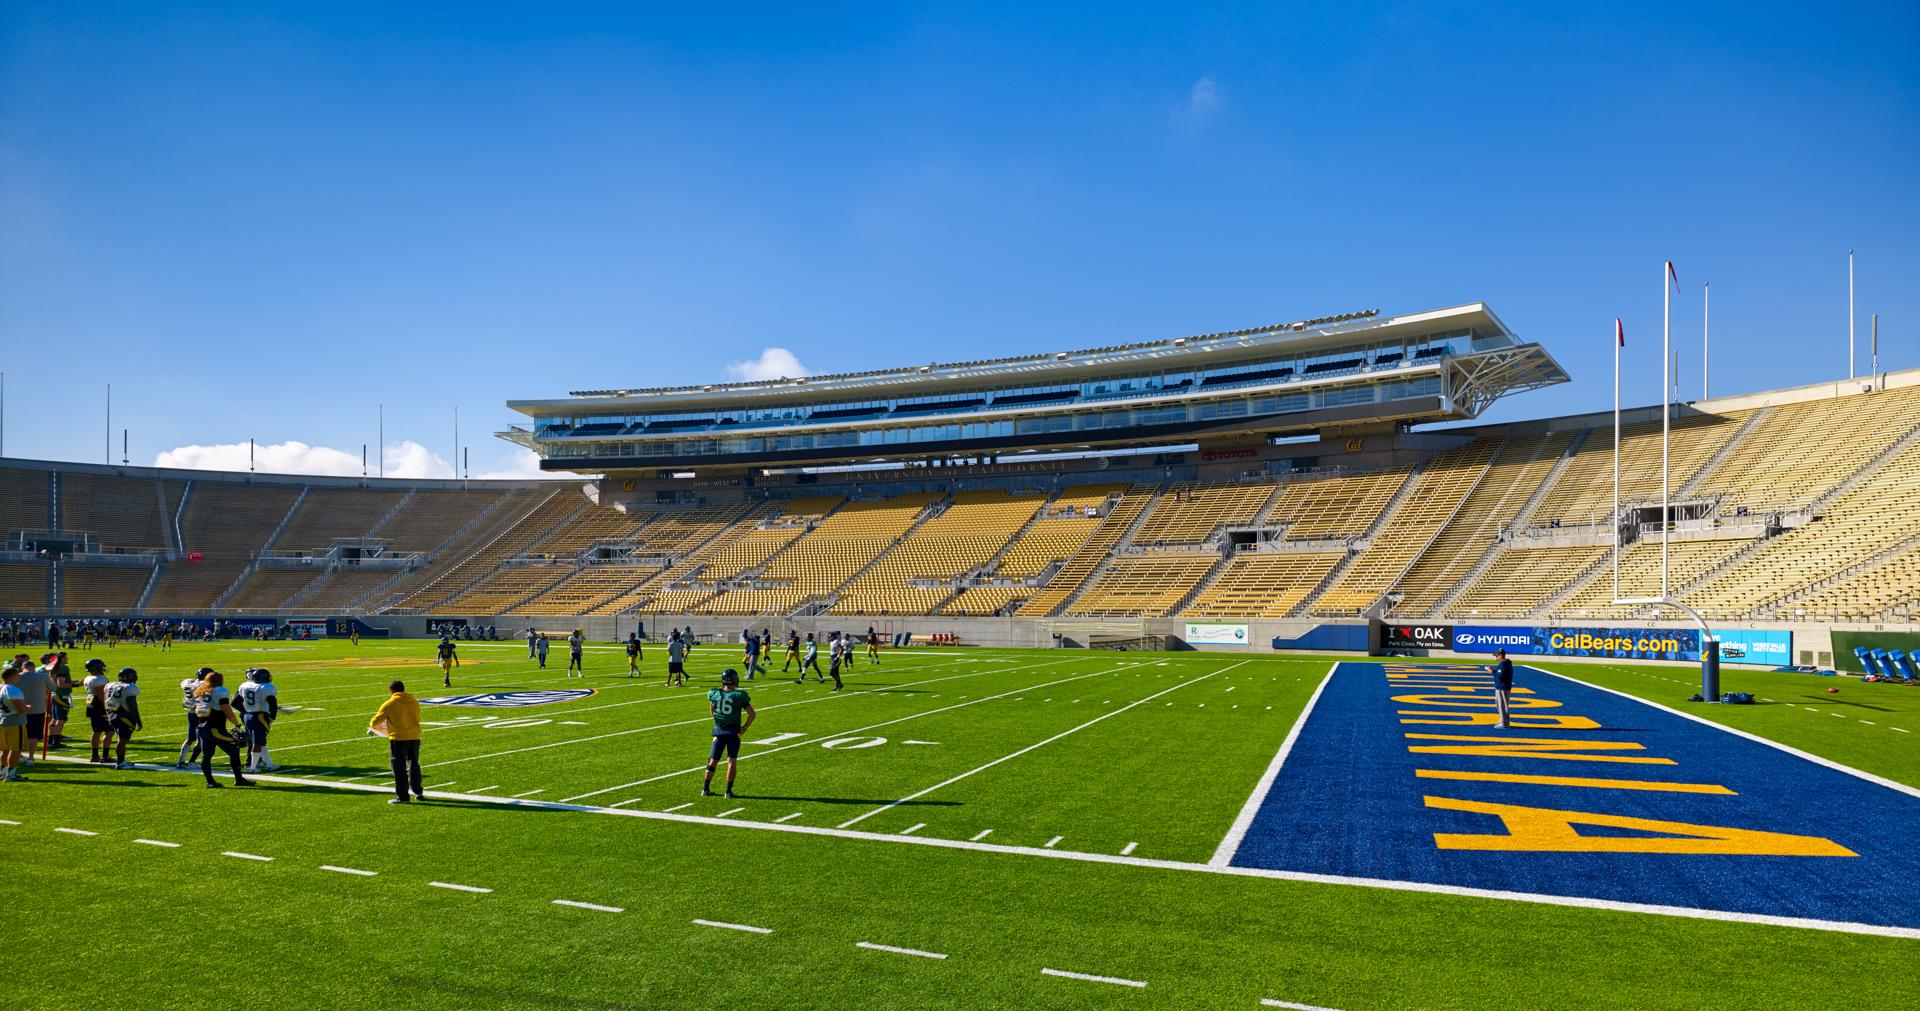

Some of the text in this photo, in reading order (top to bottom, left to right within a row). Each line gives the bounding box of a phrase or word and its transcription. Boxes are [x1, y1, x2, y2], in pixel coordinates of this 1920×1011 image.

[1345, 437, 1365, 451] Cal
[1217, 450, 1258, 459] TOYOTA
[845, 469, 933, 481] UNIVERSITY
[968, 462, 1067, 475] CALIFORNIA
[335, 623, 347, 633] 12
[1388, 627, 1444, 639] I OAK
[1478, 635, 1530, 645] HYUNDAI
[1550, 633, 1679, 652] CalBears.com
[246, 690, 256, 706] 9
[714, 697, 733, 714] 16
